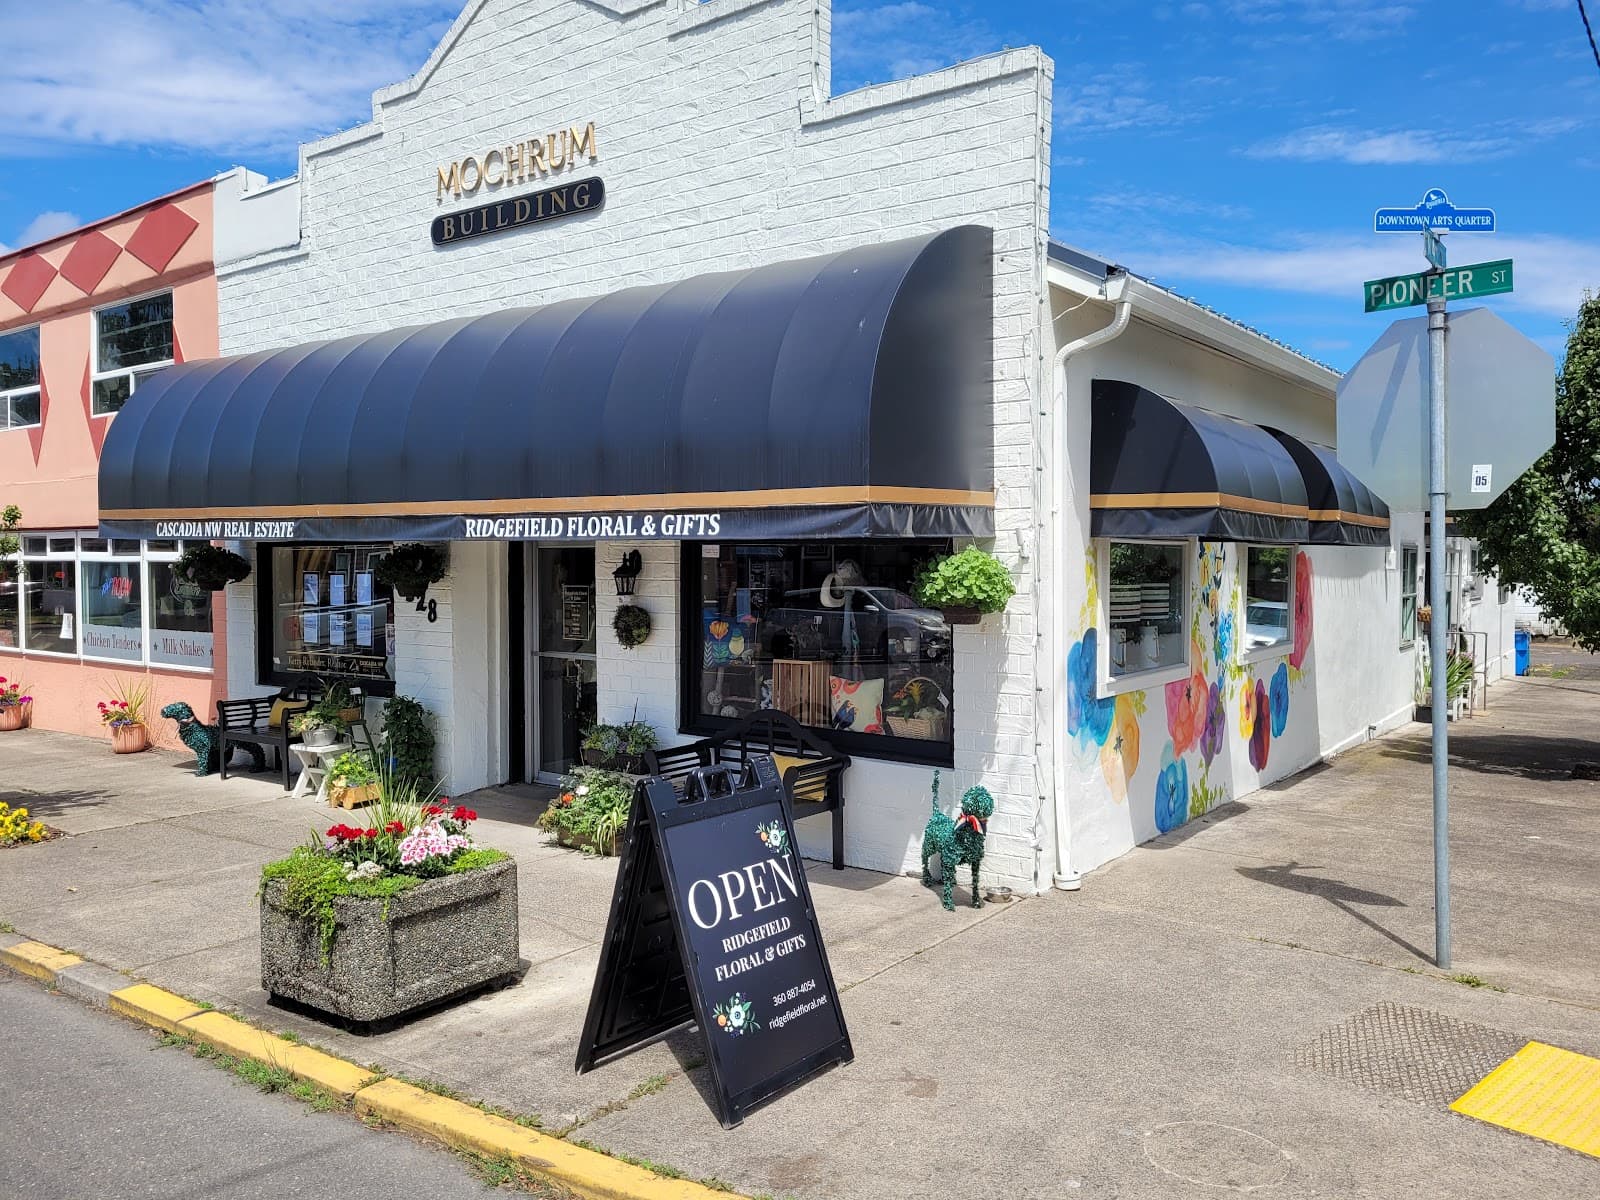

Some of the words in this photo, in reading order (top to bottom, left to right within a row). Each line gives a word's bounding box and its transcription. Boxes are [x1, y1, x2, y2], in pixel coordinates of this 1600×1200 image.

[436, 121, 597, 201] MOCHRUM
[442, 183, 591, 240] BUILDING
[1379, 215, 1430, 226] DOWNTOWN
[1431, 215, 1453, 225] ARTS
[1454, 215, 1492, 227] QUARTER
[1370, 270, 1474, 307] PIONEER
[1491, 270, 1507, 284] ST
[1475, 475, 1488, 486] 05
[156, 521, 203, 537] CASCADIA
[204, 521, 222, 537] NW
[223, 521, 252, 538] REAL
[254, 521, 295, 538] ESTATE
[465, 517, 563, 538] RIDGEFIELD
[566, 515, 637, 537] FLORAL
[641, 514, 657, 536] &
[660, 513, 721, 536] GIFTS
[86, 631, 111, 648] Chicken
[112, 633, 138, 650] Tenders
[162, 637, 178, 655] Milk
[179, 639, 205, 657] Shakes
[688, 853, 798, 929] OPEN
[721, 916, 791, 953] RIDGEFIELD
[714, 951, 765, 982] FLORAL
[764, 946, 775, 962] &
[776, 933, 806, 957] GIFTS
[772, 992, 787, 1007] 360
[786, 979, 816, 1001] 887-4054
[768, 994, 828, 1030] ridgefieldfloral.net
